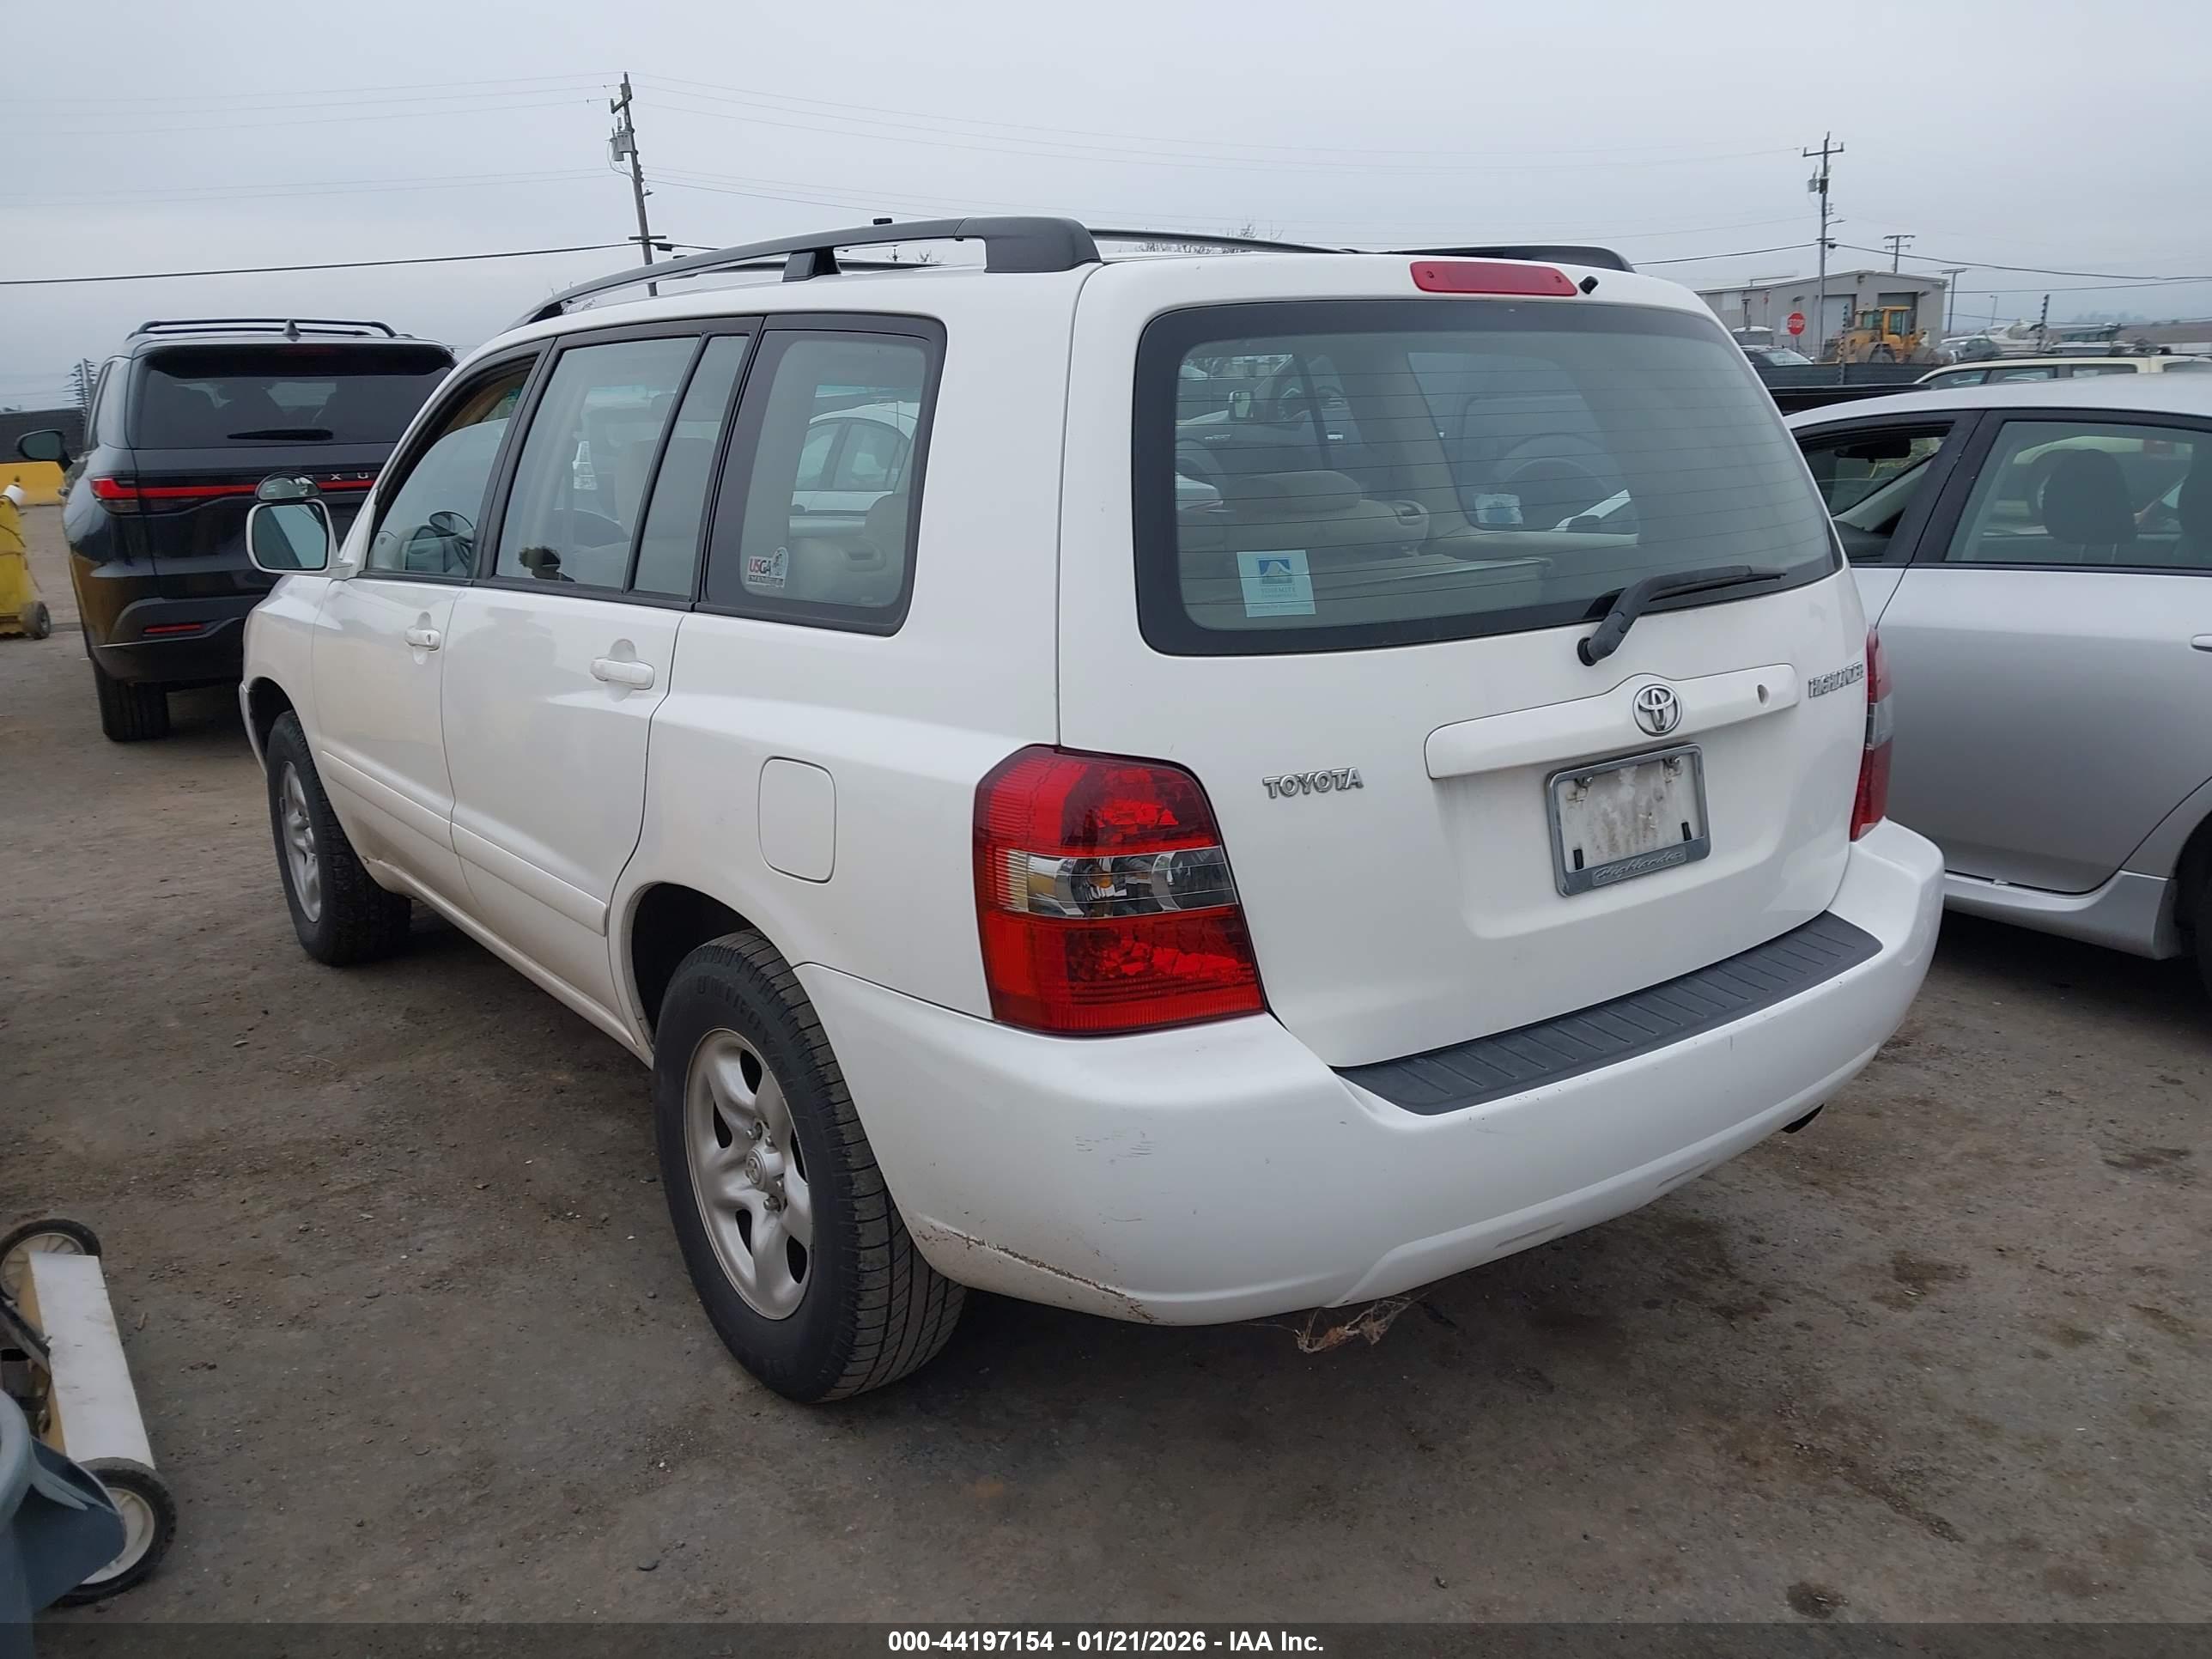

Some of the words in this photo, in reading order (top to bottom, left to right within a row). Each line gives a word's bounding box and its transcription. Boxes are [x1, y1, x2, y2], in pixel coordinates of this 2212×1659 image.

[1808, 661, 1863, 698] HIGHLANDE
[1262, 767, 1364, 799] TOYOTA
[1594, 851, 1684, 879] Highlander
